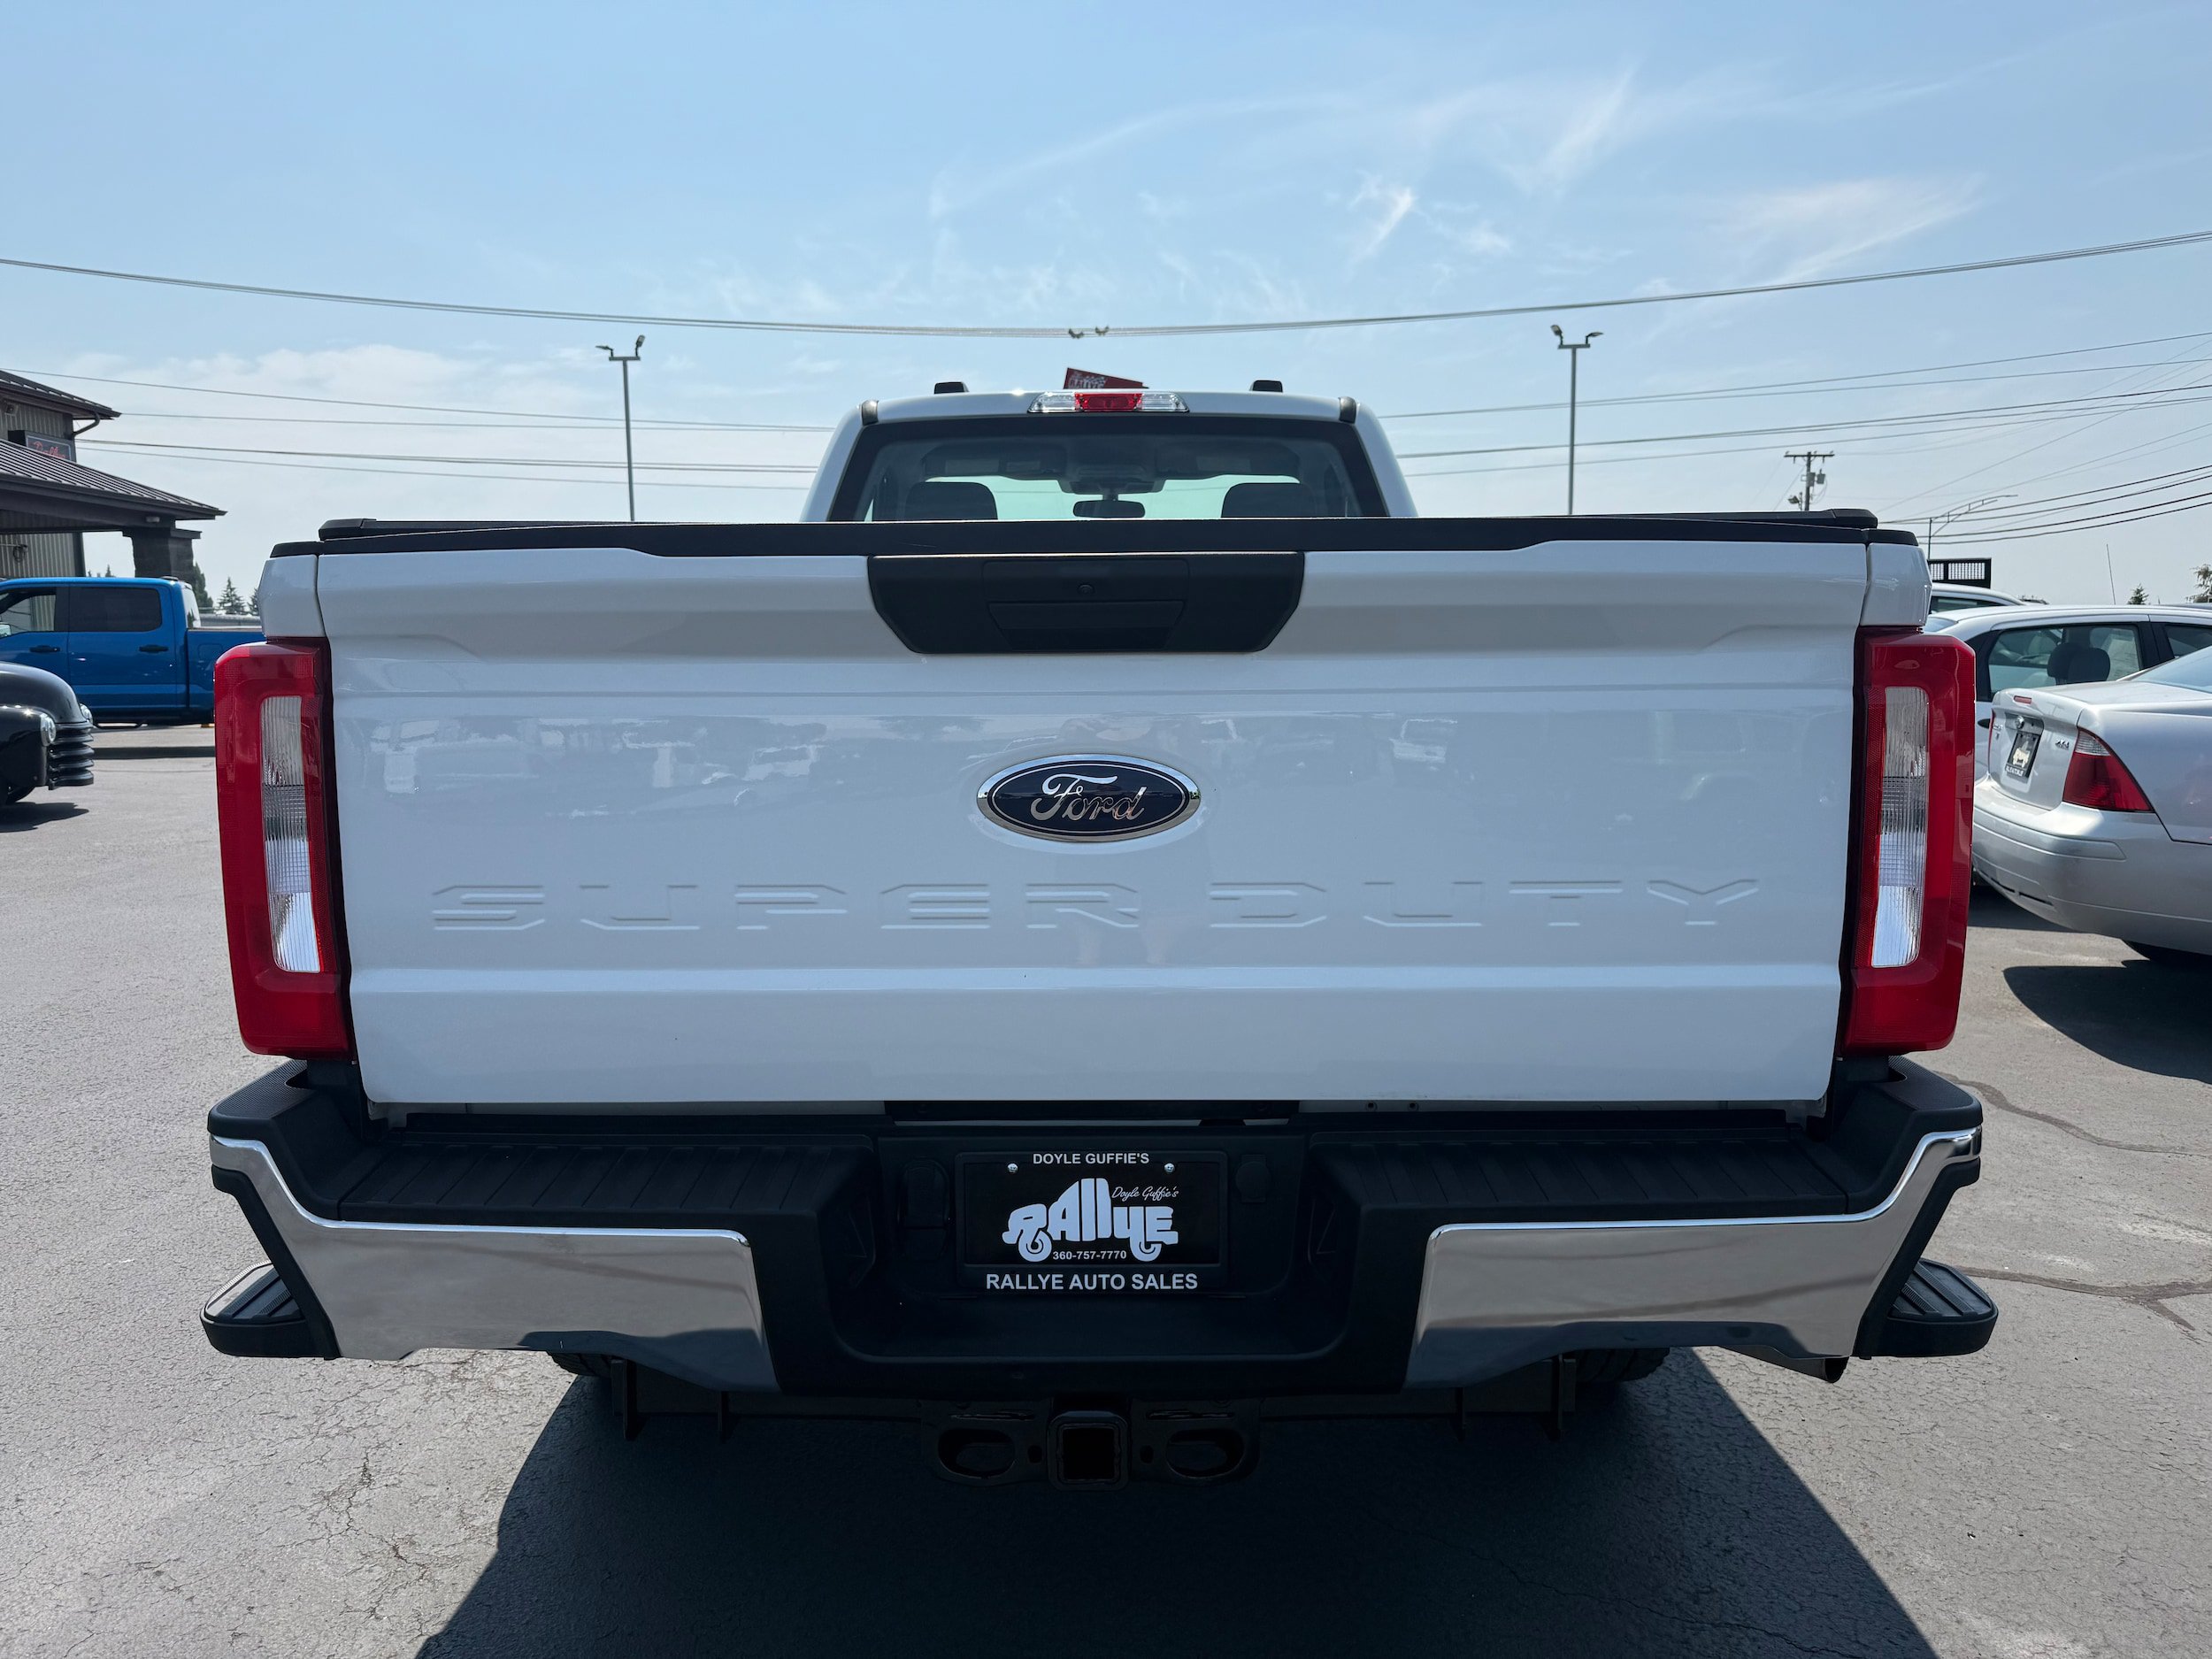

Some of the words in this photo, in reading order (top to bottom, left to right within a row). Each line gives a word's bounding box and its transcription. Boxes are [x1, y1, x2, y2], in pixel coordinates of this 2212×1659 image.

[1031, 773, 1147, 821] Ford
[432, 884, 1140, 931] SUPER
[1210, 879, 1759, 928] DUTY
[1033, 1153, 1081, 1164] DOYLE
[1085, 1153, 1149, 1164] GUFFIE'S
[1111, 1187, 1140, 1202] Doyle
[1142, 1186, 1179, 1202] Guffie's
[1053, 1250, 1126, 1260] 360-757-7770
[987, 1274, 1064, 1290] RALLYE
[1069, 1274, 1125, 1290] AUTO
[1132, 1273, 1198, 1290] SALES
